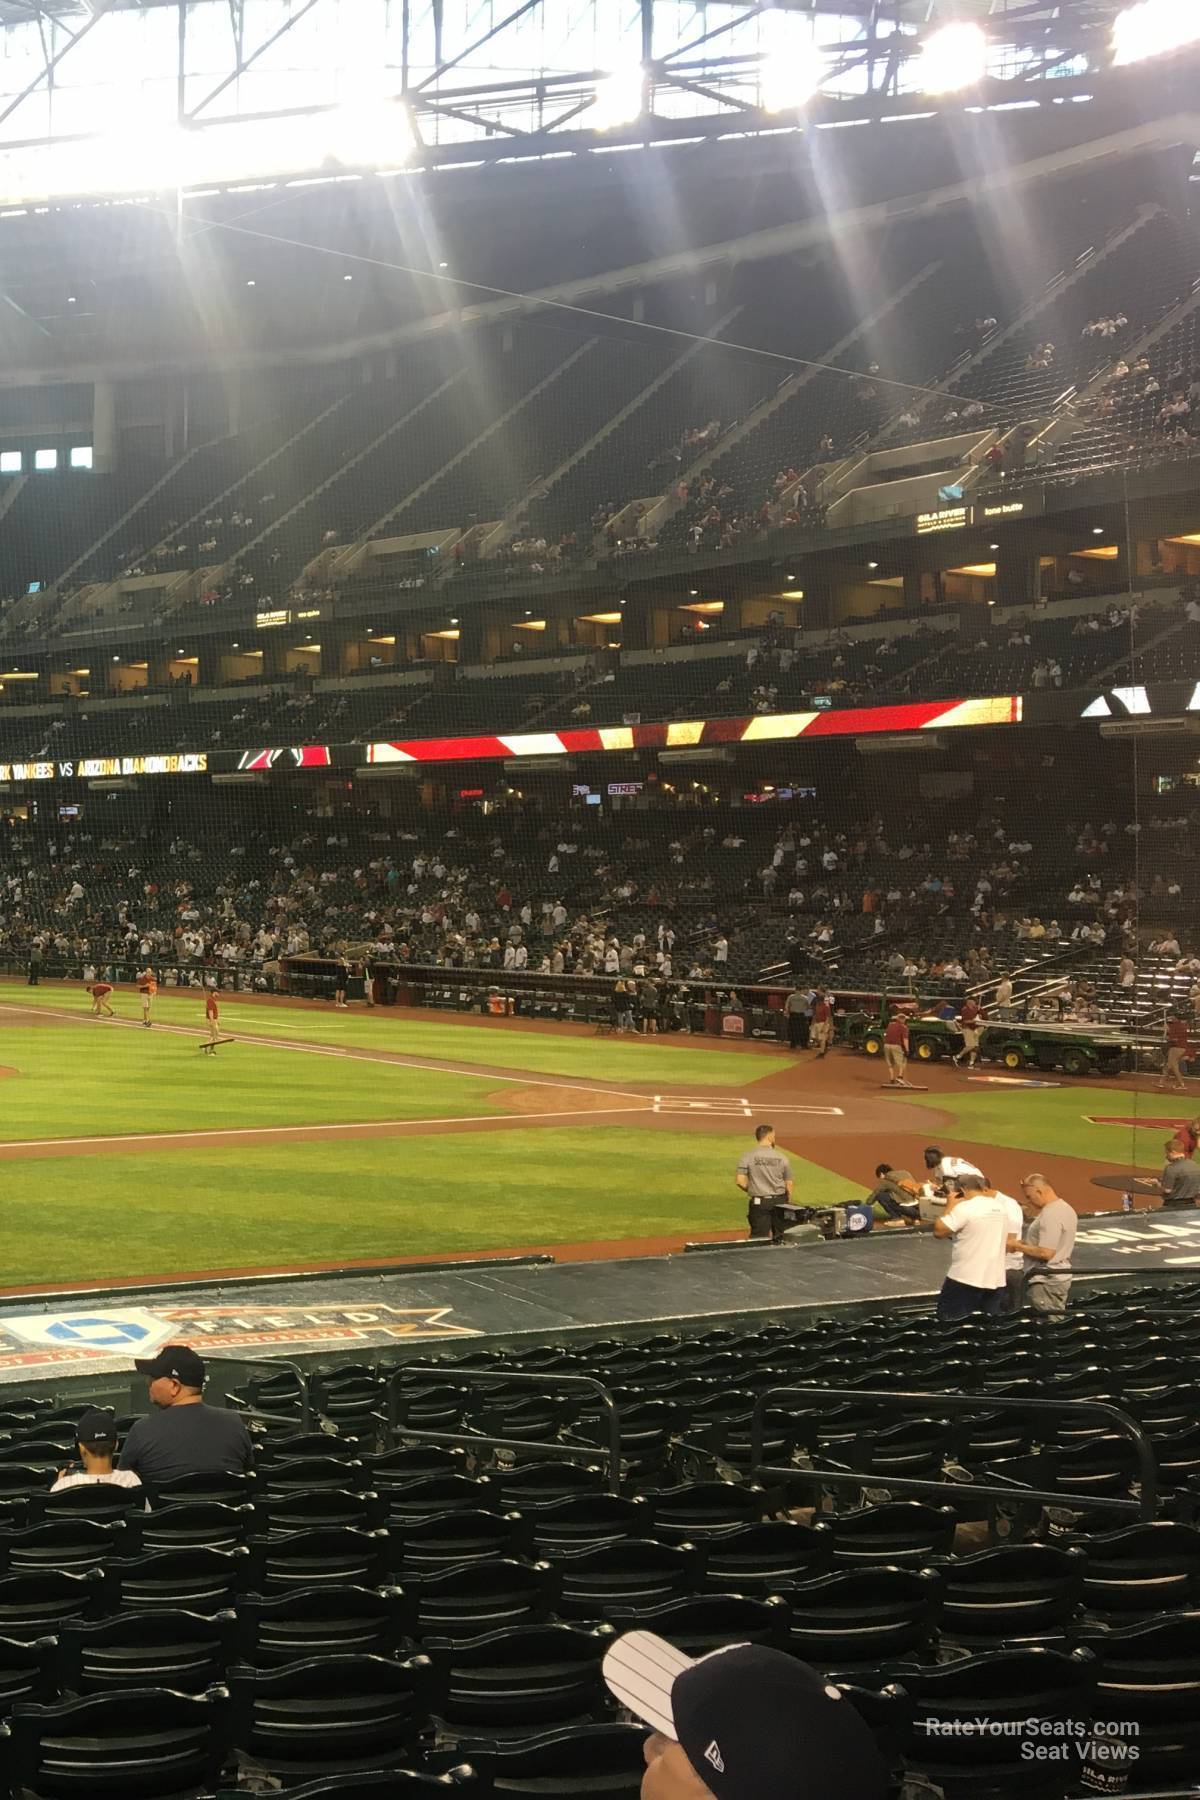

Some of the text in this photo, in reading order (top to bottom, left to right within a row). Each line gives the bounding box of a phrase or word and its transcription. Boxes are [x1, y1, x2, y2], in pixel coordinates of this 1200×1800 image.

[918, 508, 966, 522] GILA RIVER
[12, 762, 54, 780] YANKEES
[59, 762, 74, 776] VS
[78, 758, 120, 776] ARIZONA
[122, 754, 208, 775] DIAMONDBACKS
[192, 1312, 380, 1332] FIELD
